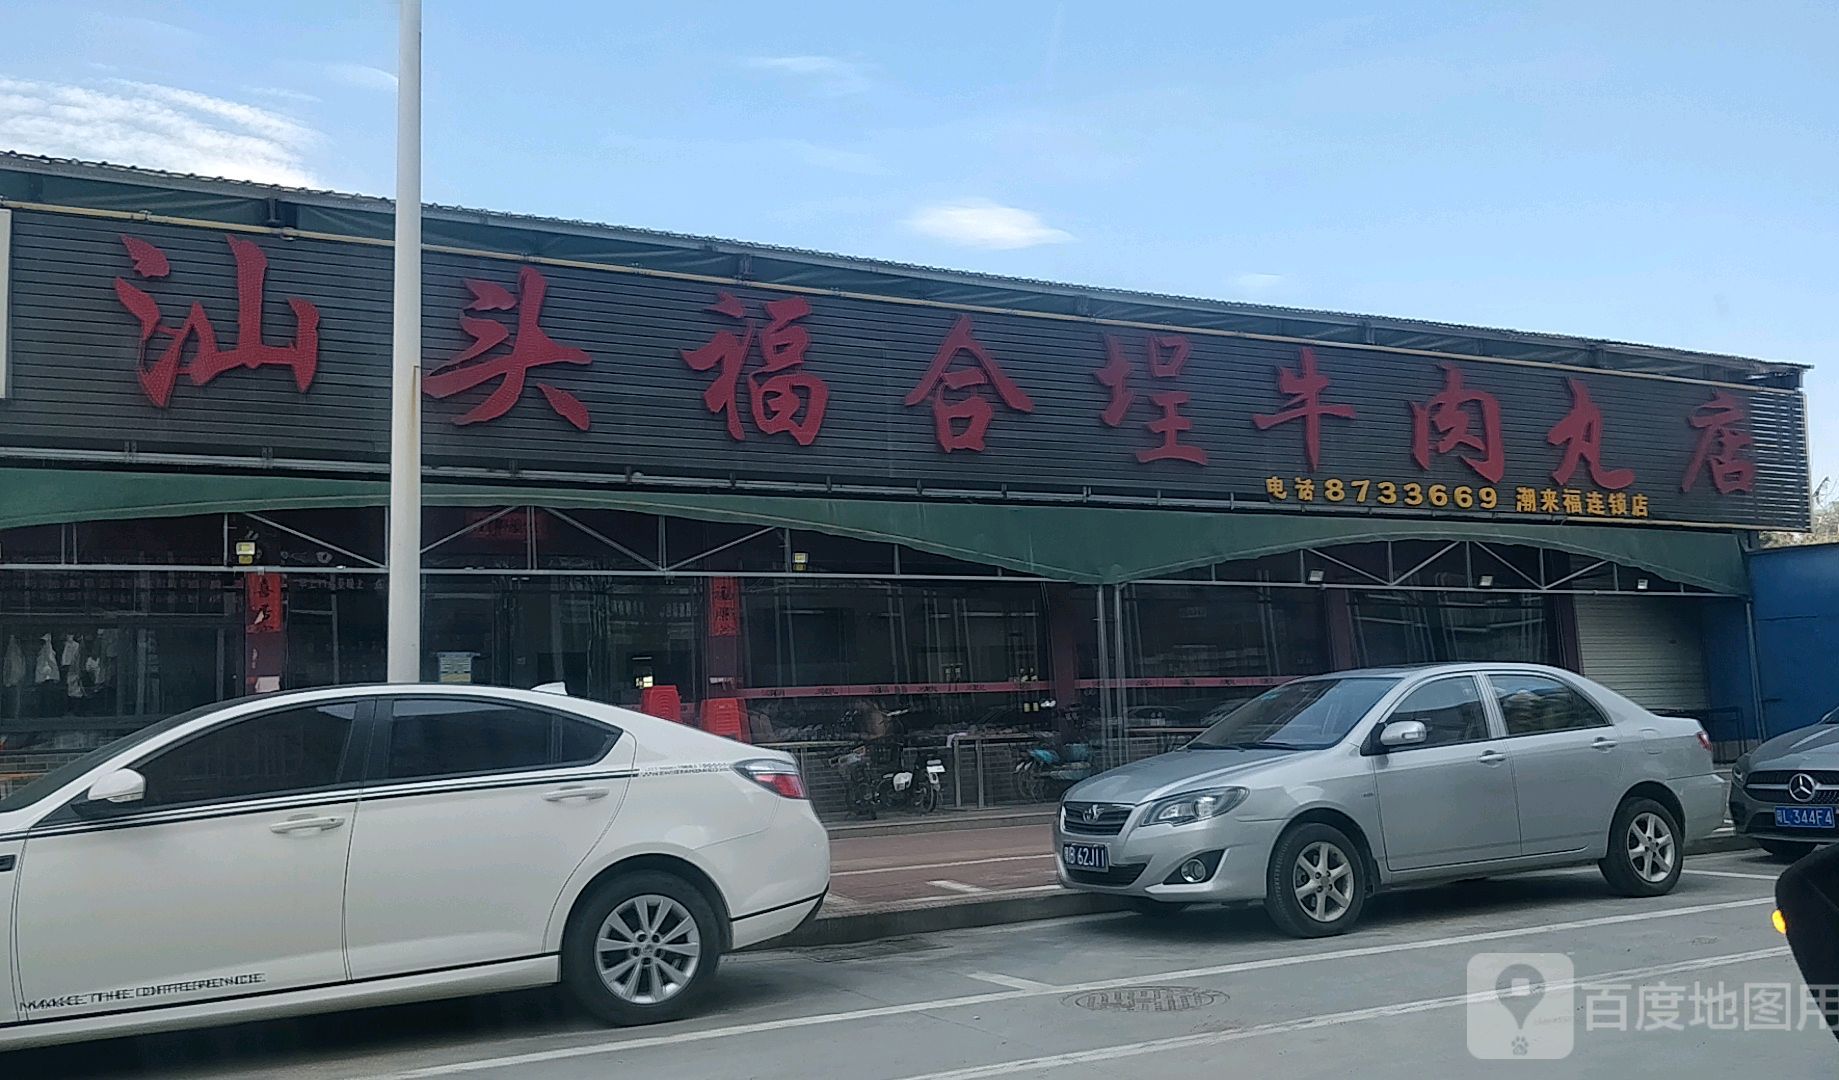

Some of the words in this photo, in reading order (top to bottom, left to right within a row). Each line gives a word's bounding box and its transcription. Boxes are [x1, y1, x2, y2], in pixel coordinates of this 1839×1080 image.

[114, 234, 1757, 495] 汕头福合埕牛肉丸店
[1515, 486, 1650, 518] 潮来福连锁店
